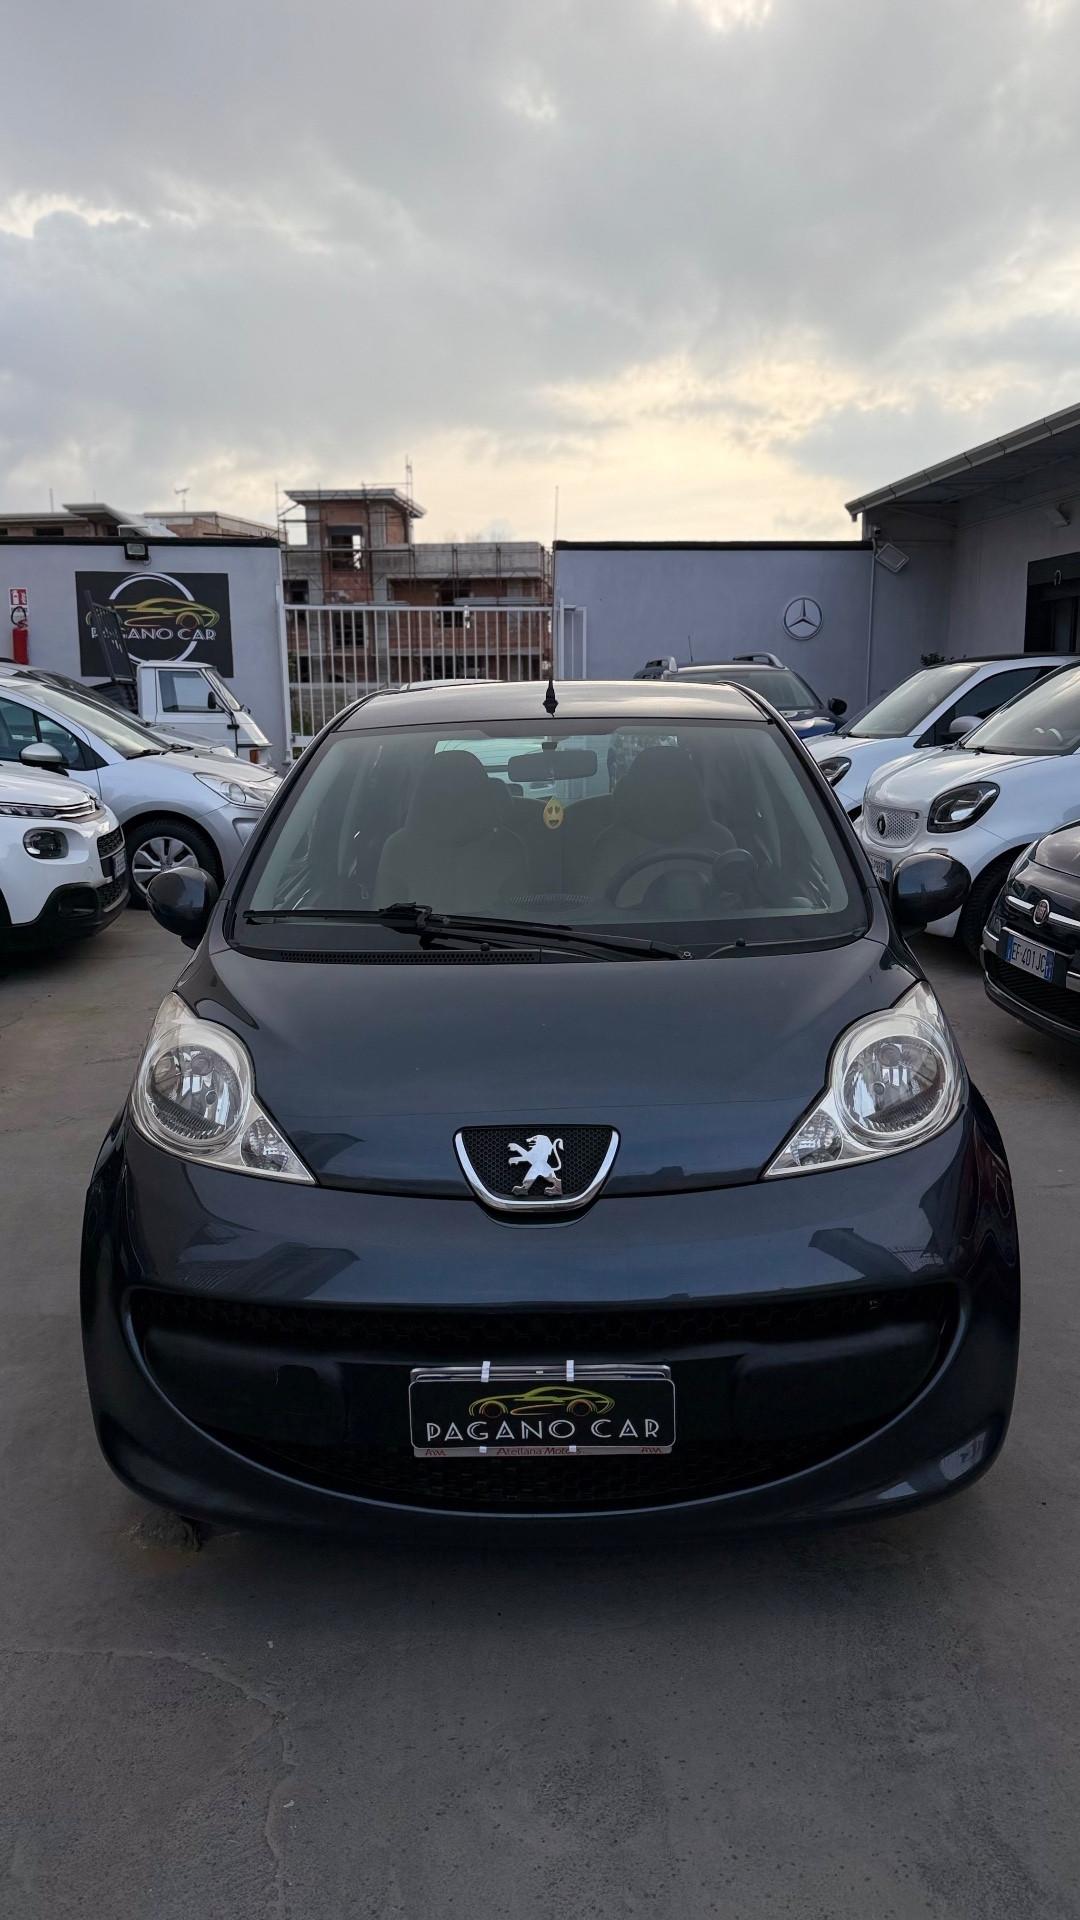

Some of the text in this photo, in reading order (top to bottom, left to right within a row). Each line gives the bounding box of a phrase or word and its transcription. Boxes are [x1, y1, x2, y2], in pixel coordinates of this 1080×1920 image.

[177, 627, 217, 641] CAR
[426, 1418, 660, 1442] PAGANO CAR
